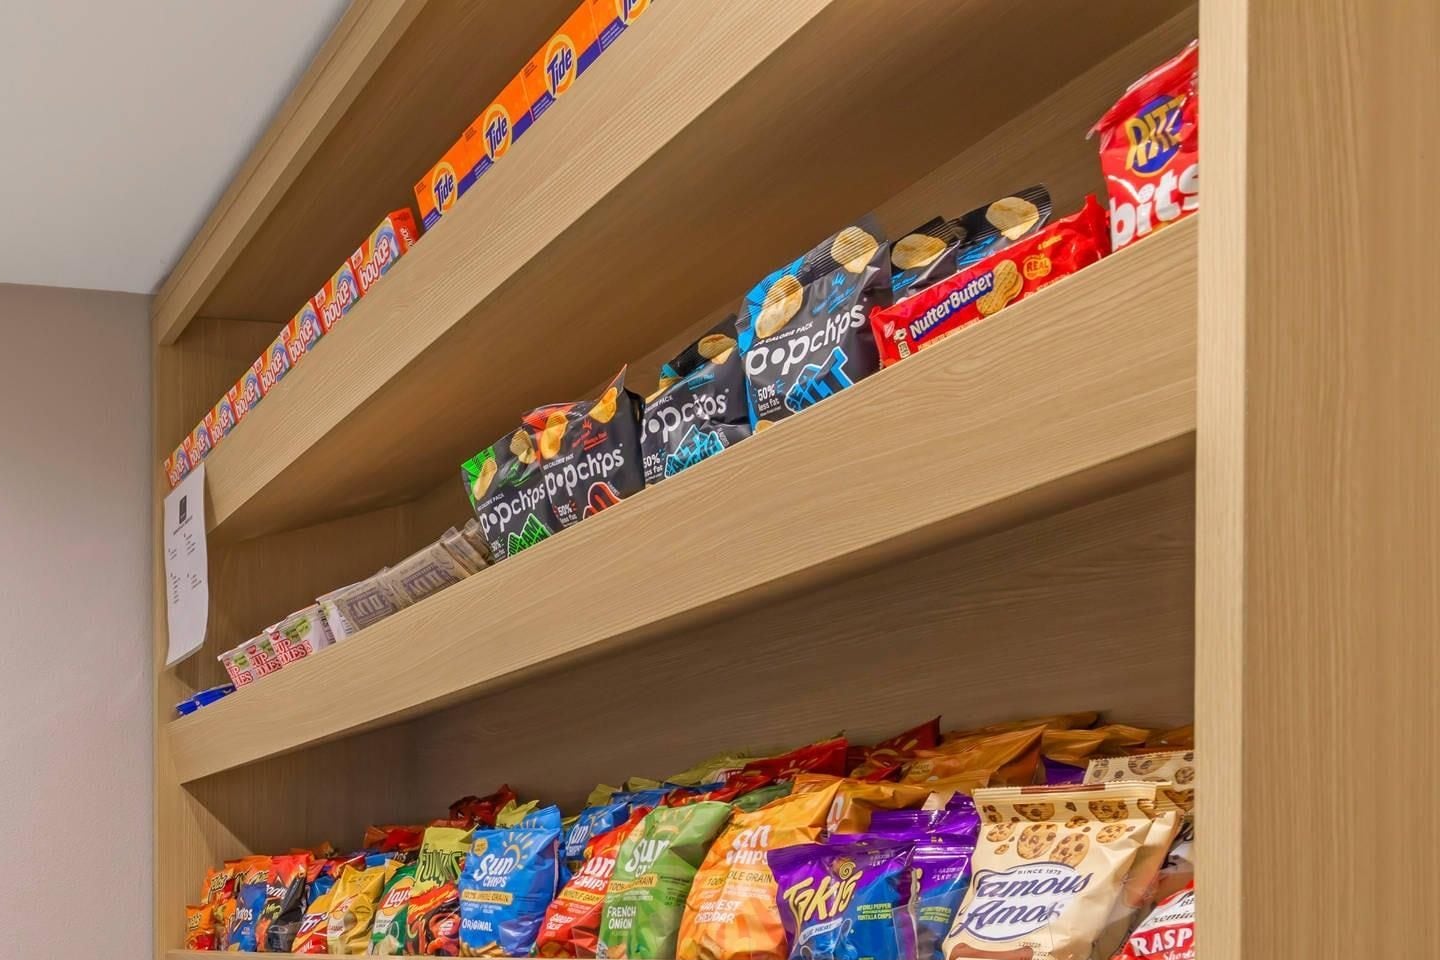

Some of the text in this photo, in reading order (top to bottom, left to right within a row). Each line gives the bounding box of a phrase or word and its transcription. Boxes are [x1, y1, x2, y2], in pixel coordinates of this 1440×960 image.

[546, 47, 573, 96] Tide
[485, 115, 508, 160] Tide
[434, 173, 454, 214] Tide
[358, 237, 390, 292] bounce
[322, 279, 351, 330] bounce
[287, 318, 314, 363] bounce
[745, 304, 866, 380] popchips
[757, 383, 776, 402] 50%
[545, 443, 625, 504] popchips
[479, 482, 546, 541] popchips
[473, 853, 515, 882] Sun
[482, 874, 507, 888] CHIPS
[976, 873, 1094, 898] Famous
[607, 905, 637, 918] FRENCH
